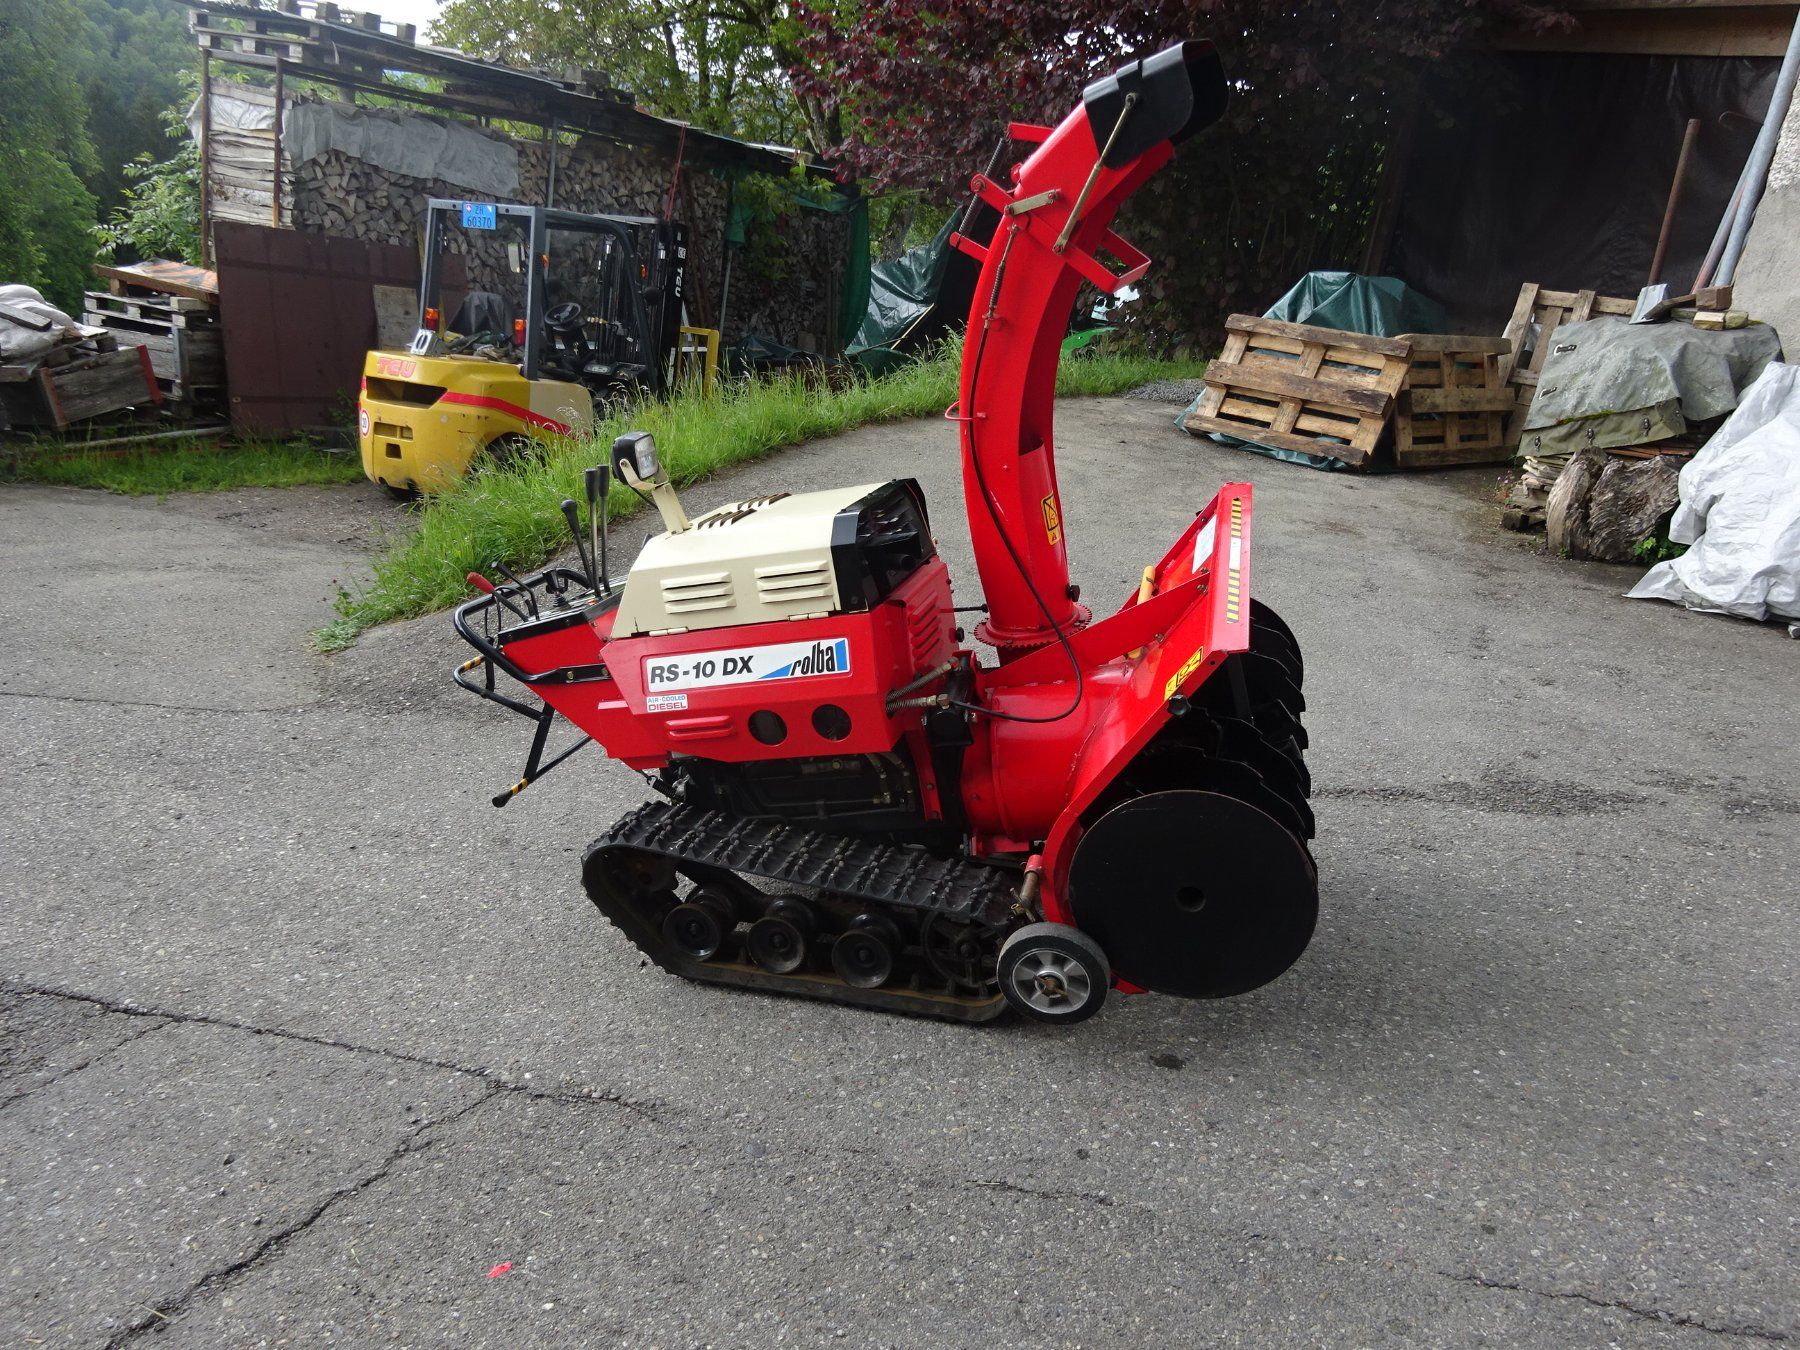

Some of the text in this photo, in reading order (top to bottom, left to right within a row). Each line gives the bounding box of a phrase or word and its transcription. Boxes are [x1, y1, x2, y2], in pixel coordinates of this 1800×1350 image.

[467, 216, 492, 228] 60370
[790, 642, 836, 676] rolba
[650, 655, 754, 683] RS-10 DX
[648, 695, 686, 703] AIR-COOLED
[648, 702, 687, 711] DIESEL
